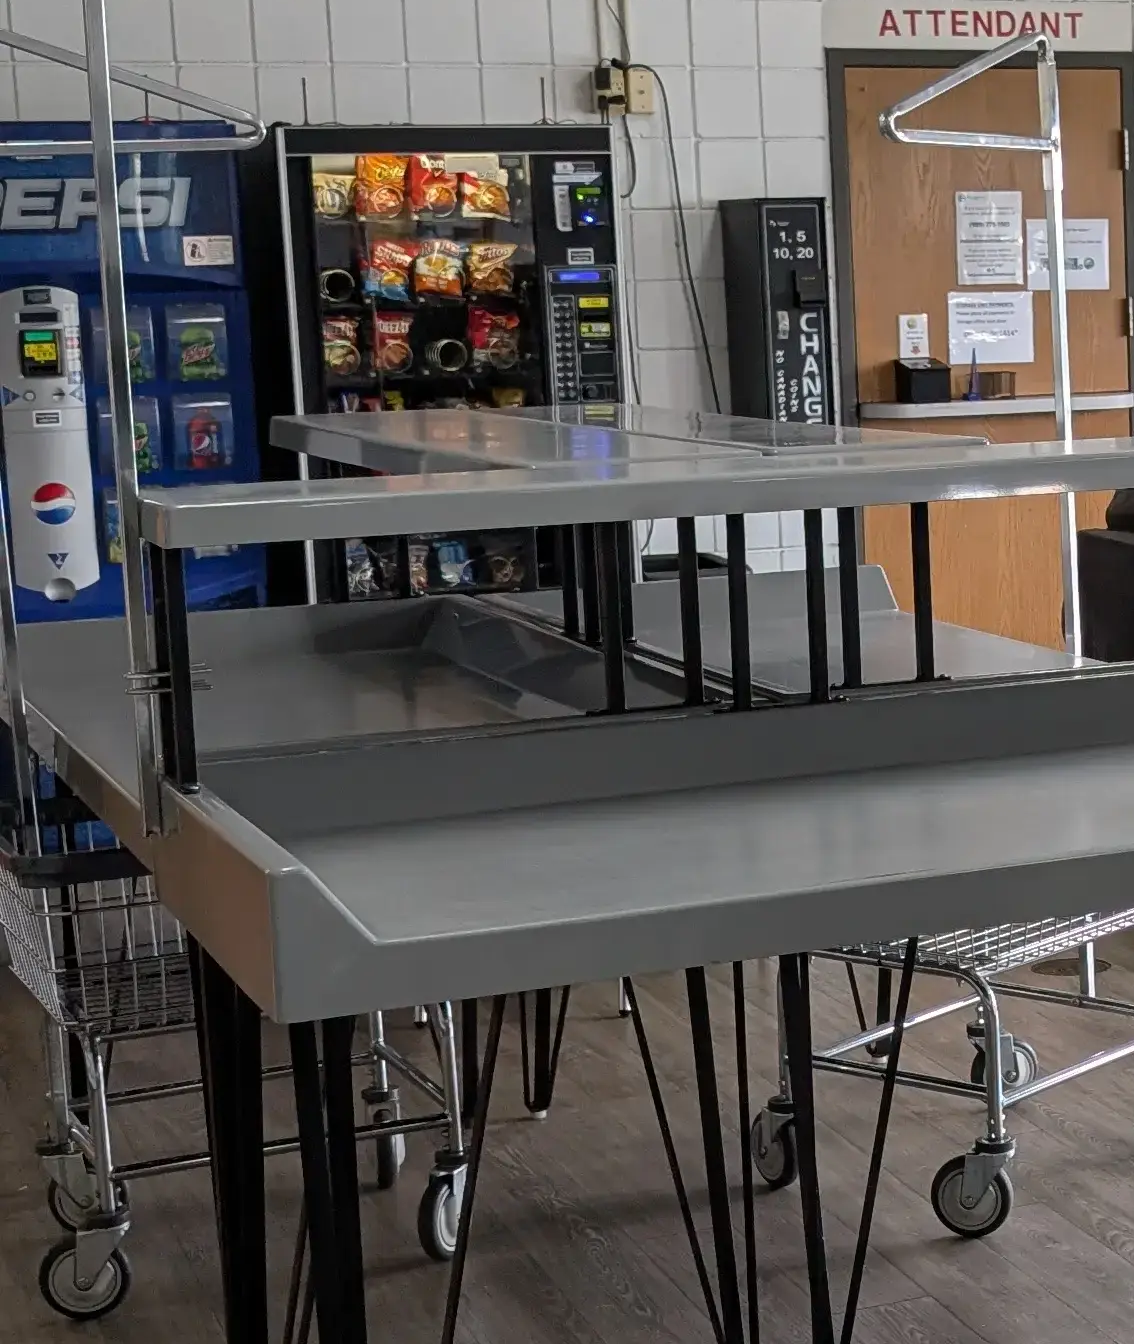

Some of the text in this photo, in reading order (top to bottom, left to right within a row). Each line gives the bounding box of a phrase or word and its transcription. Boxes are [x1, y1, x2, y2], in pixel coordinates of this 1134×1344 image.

[879, 9, 1084, 39] ATTENDANT
[0, 177, 191, 229] EPSI
[779, 230, 807, 243] 1, 5
[773, 247, 815, 260] 10, 20
[775, 350, 785, 364] NO
[800, 312, 824, 424] CHANG
[790, 379, 799, 413] COINS
